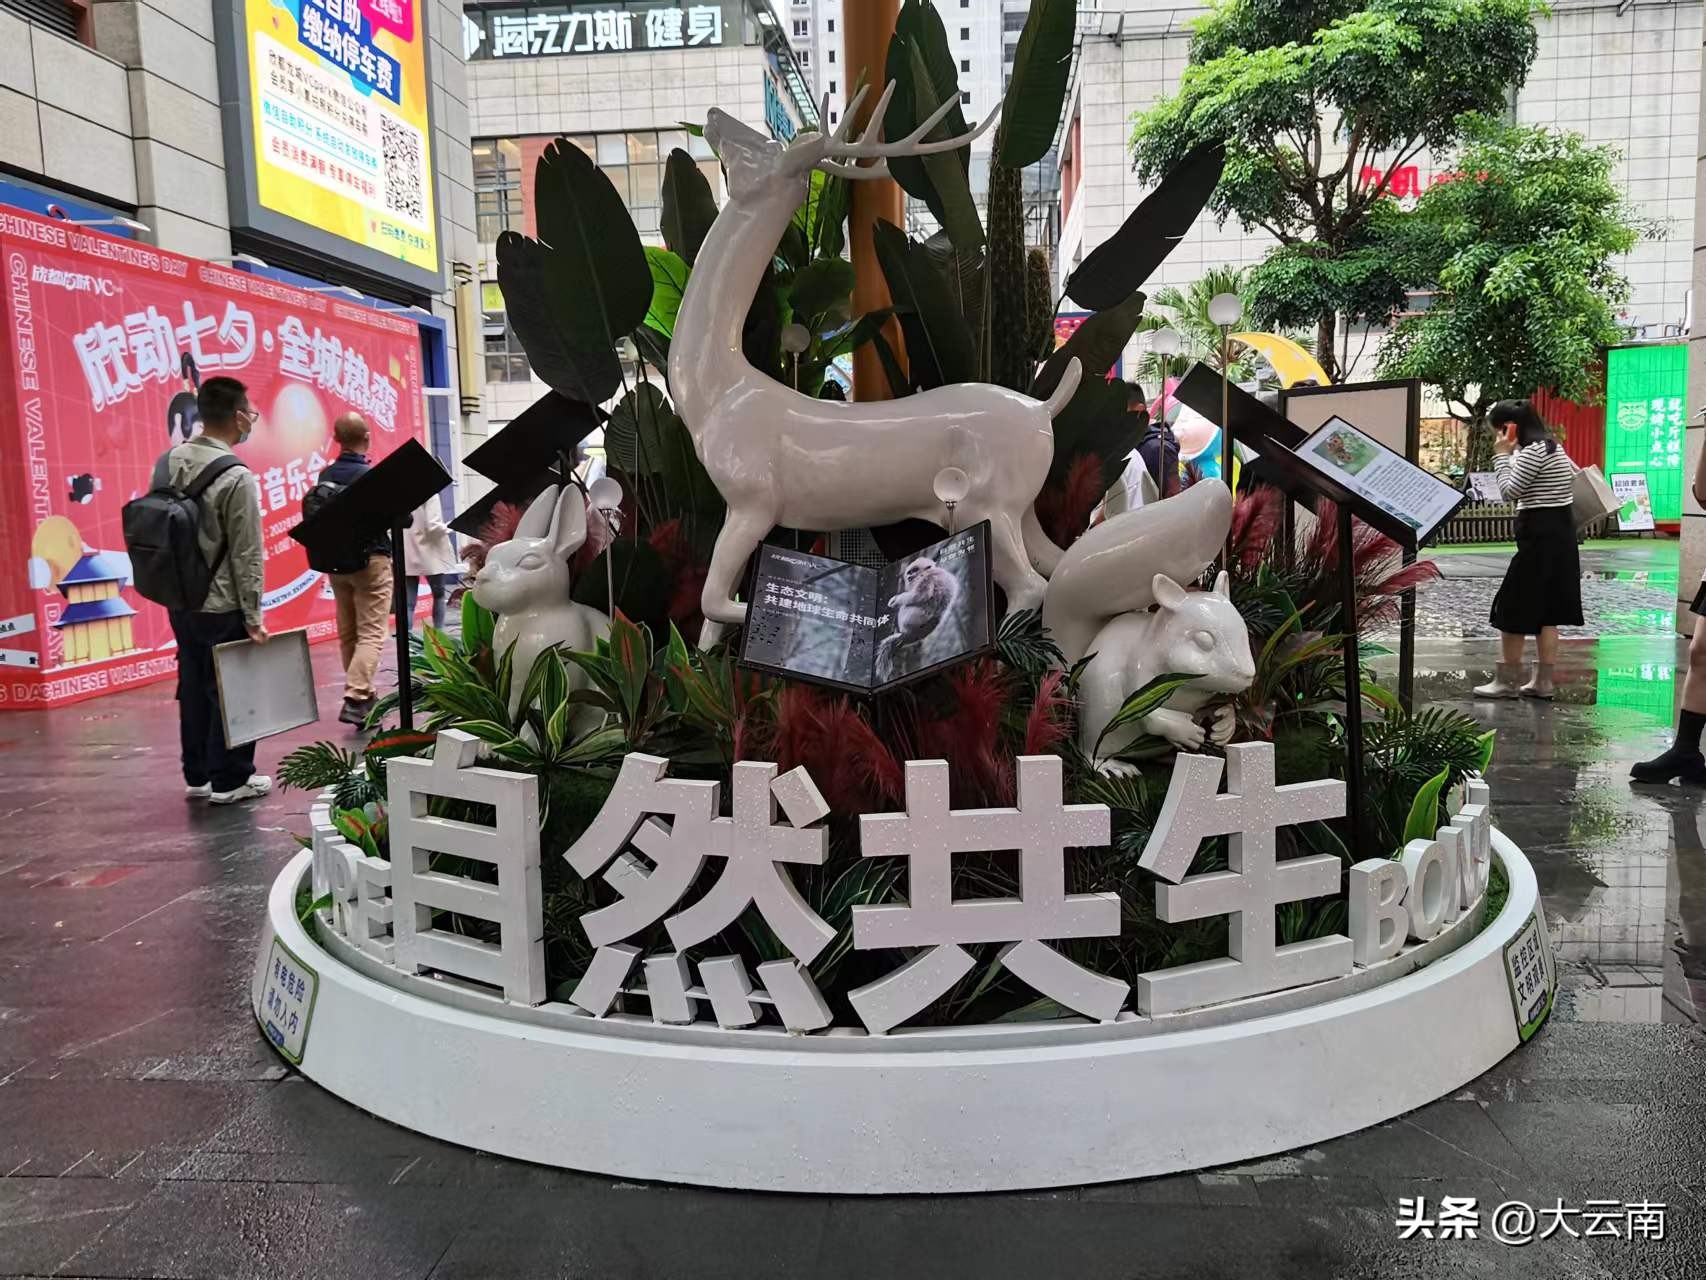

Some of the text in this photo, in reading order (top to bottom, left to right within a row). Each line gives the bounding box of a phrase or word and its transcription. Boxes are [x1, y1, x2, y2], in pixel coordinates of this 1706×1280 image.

[303, 4, 393, 96] 缴纳停车费
[645, 4, 723, 48] 健身
[9, 252, 40, 392] CHINESE
[764, 594, 890, 628] 共建地球生命共同体
[387, 728, 1354, 1036] 自然共生
